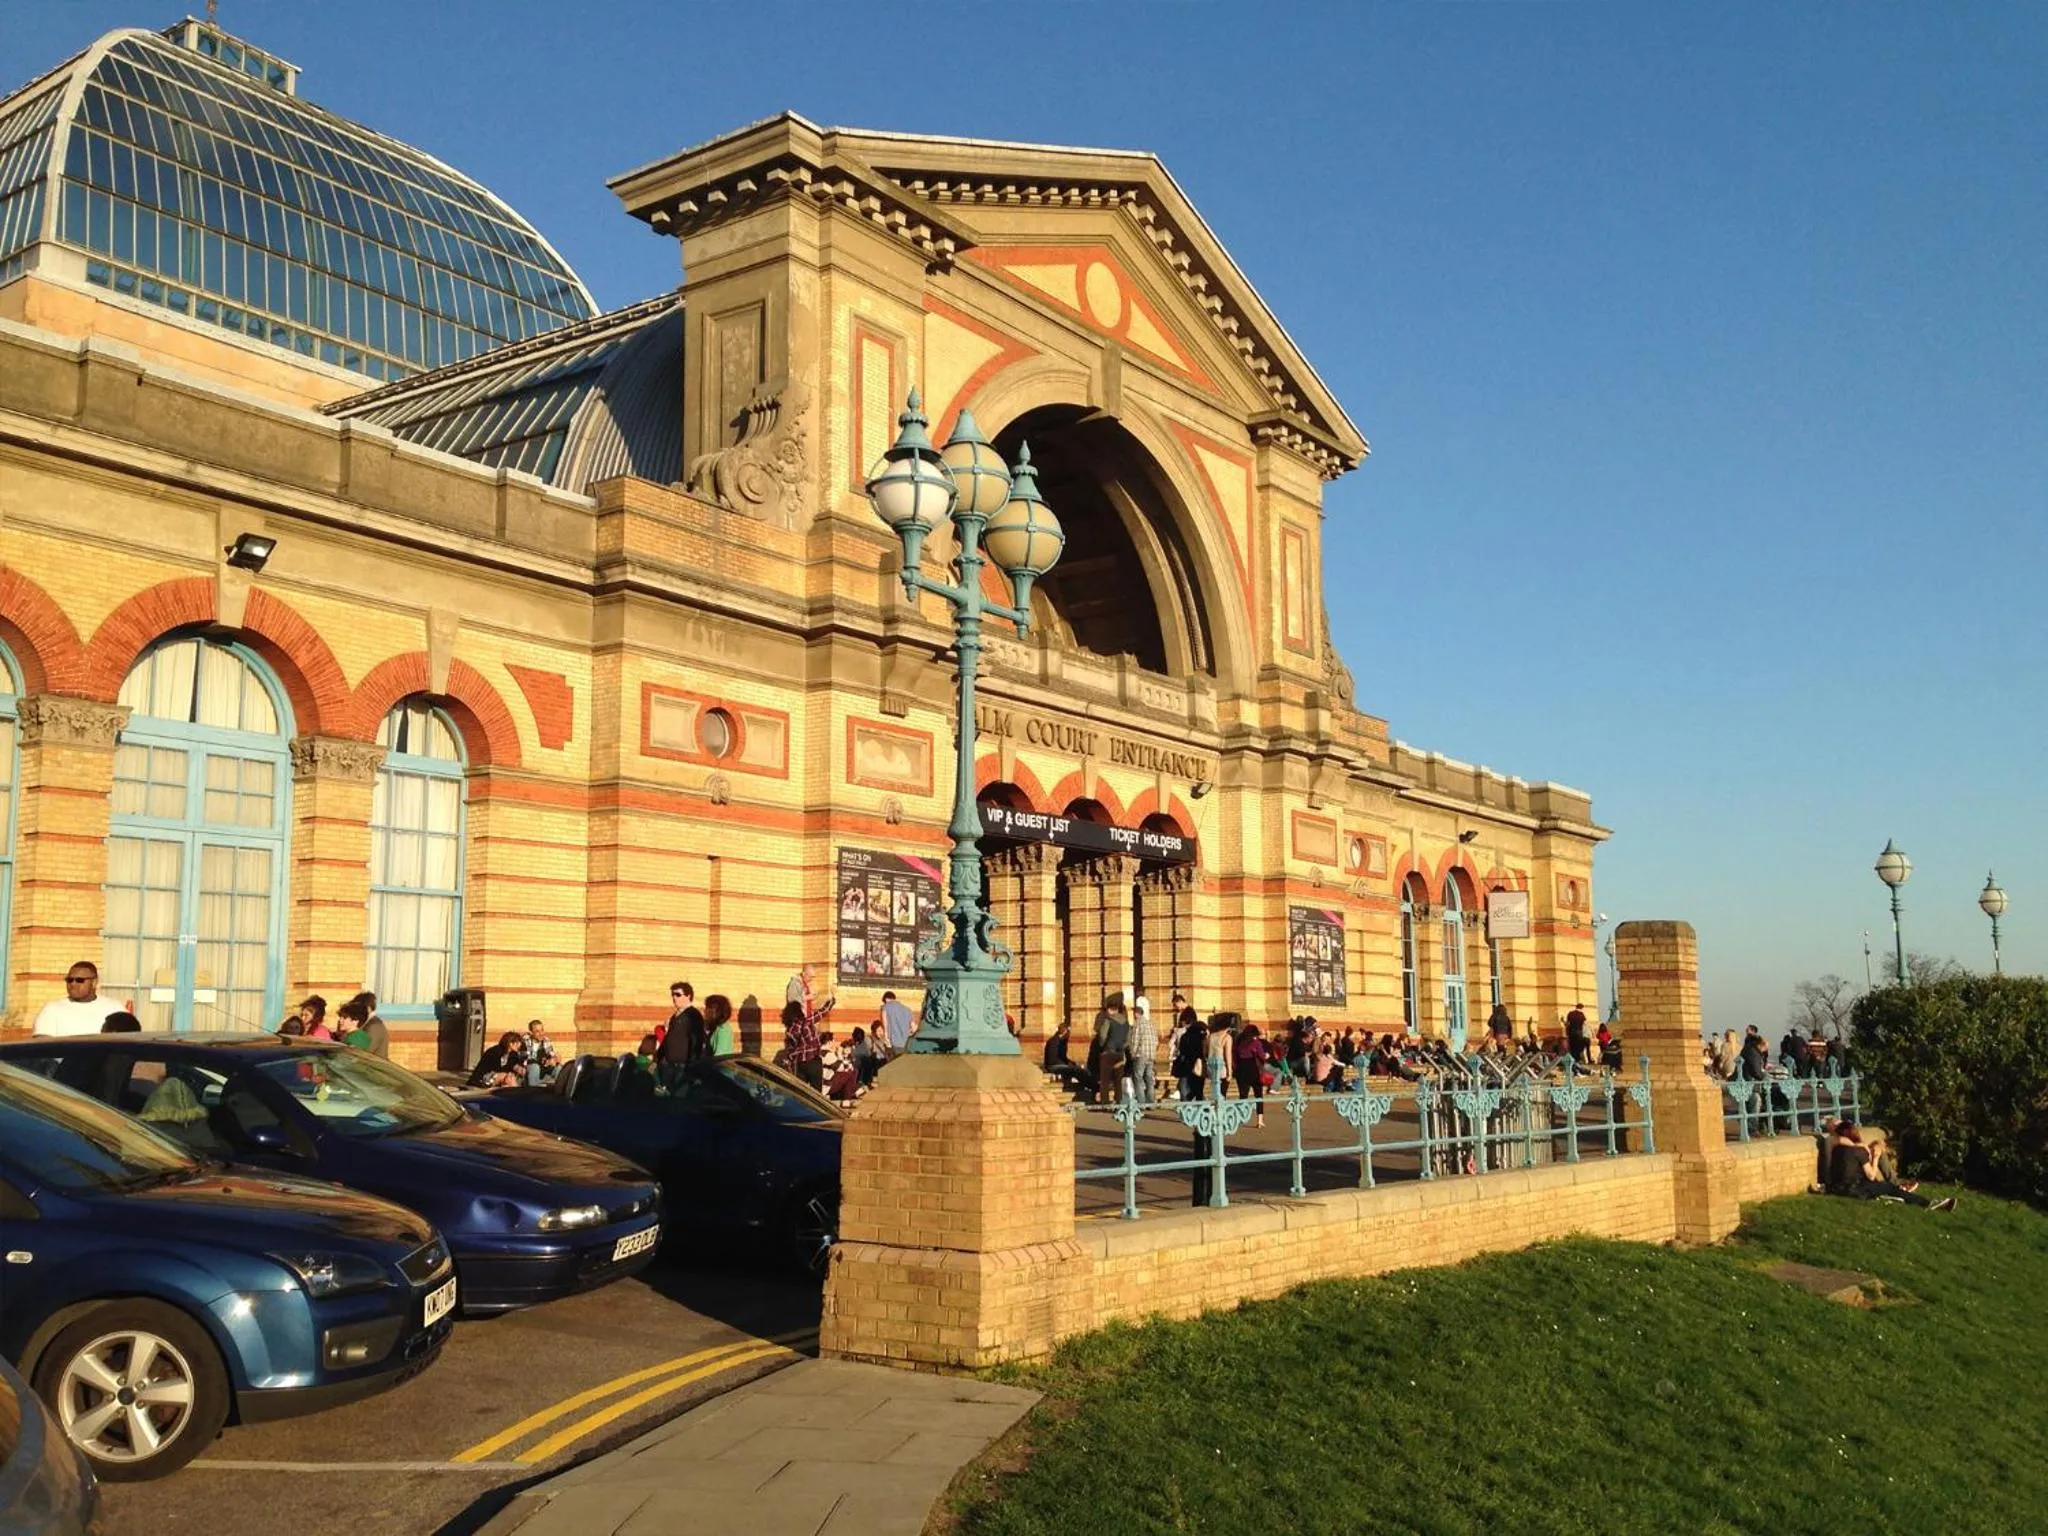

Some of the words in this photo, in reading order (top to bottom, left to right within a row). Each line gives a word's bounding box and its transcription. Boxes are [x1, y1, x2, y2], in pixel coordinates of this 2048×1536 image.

[1026, 718, 1098, 756] COURT
[1110, 736, 1207, 781] ENTRANCE
[987, 808, 1004, 823] VIP
[1005, 811, 1013, 825] &
[1015, 812, 1048, 829] GUEST
[1049, 817, 1070, 833] LIST
[1109, 827, 1140, 844] TICKET
[1143, 832, 1182, 851] HOLDERS
